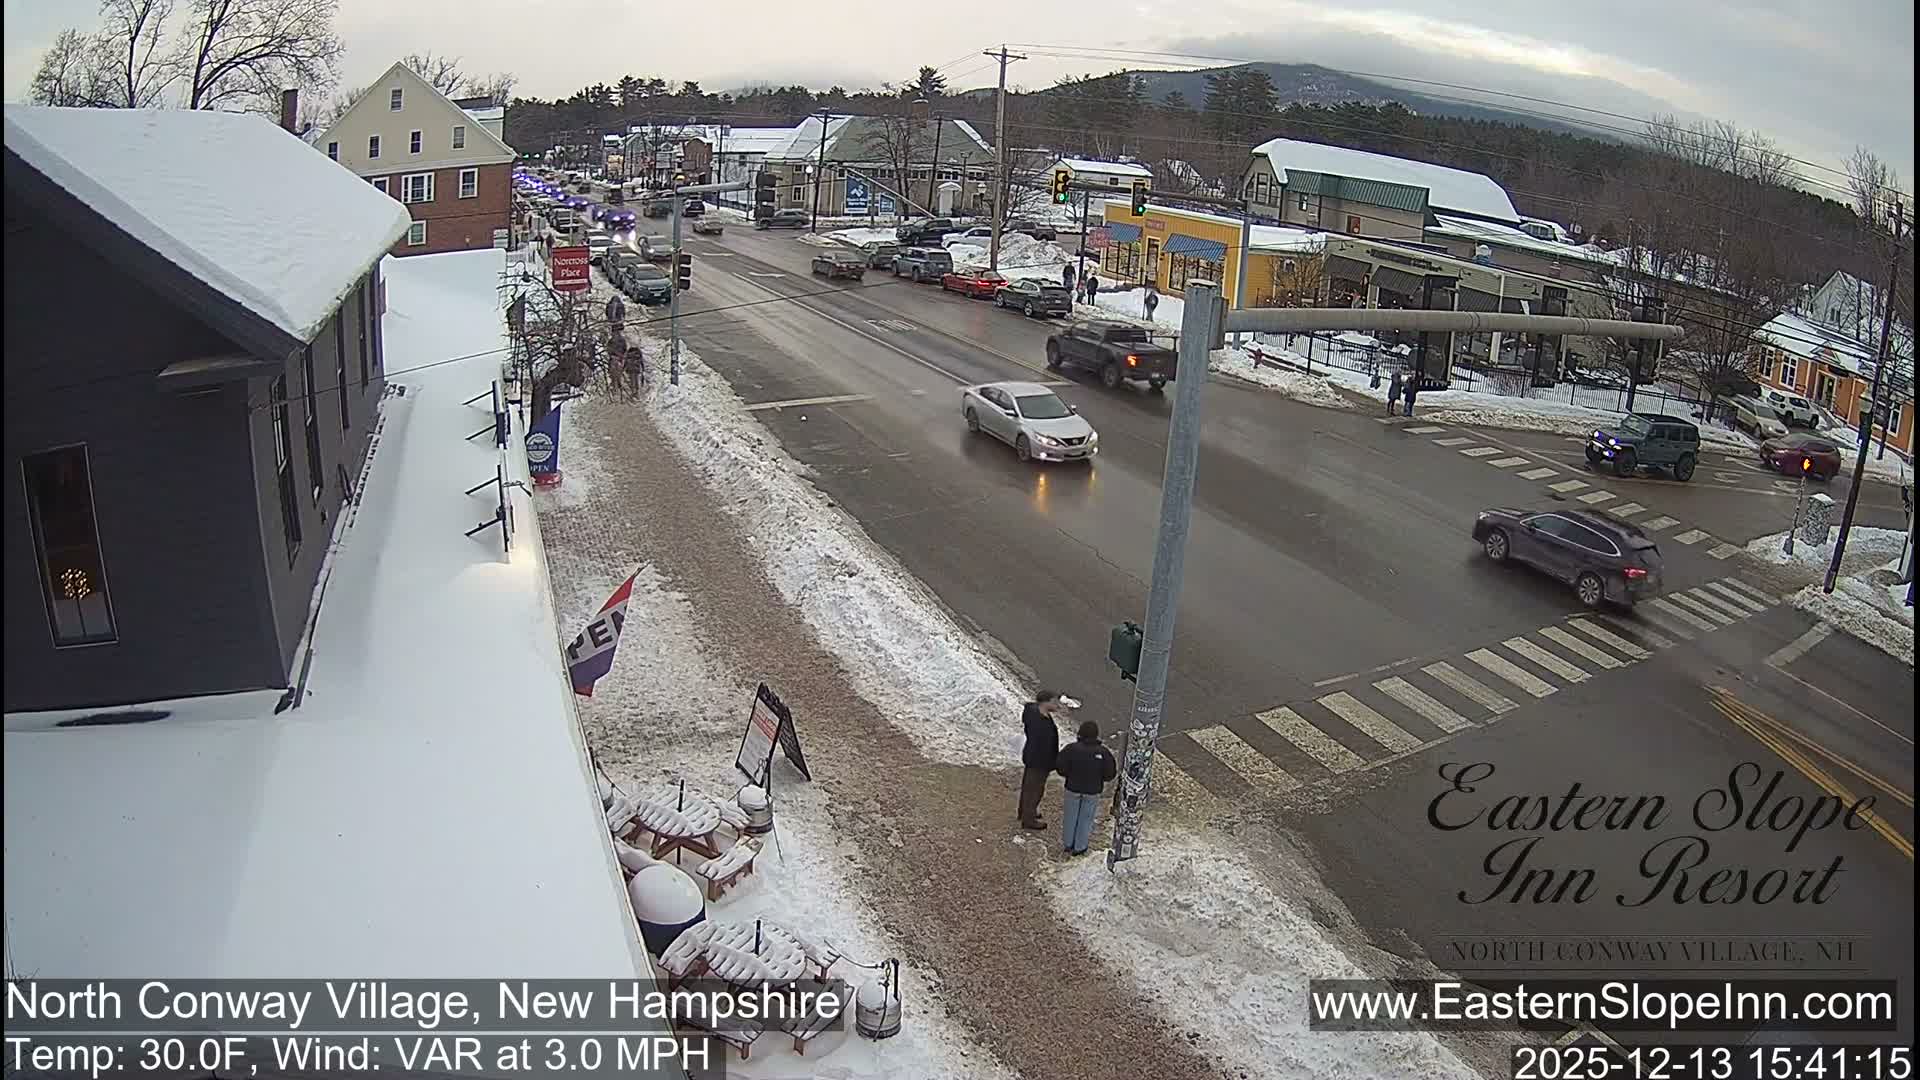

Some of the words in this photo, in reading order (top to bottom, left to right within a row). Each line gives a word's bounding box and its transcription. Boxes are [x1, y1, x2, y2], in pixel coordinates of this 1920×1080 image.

[554, 257, 588, 266] Norcross
[561, 268, 581, 277] Place
[530, 464, 550, 472] PEN
